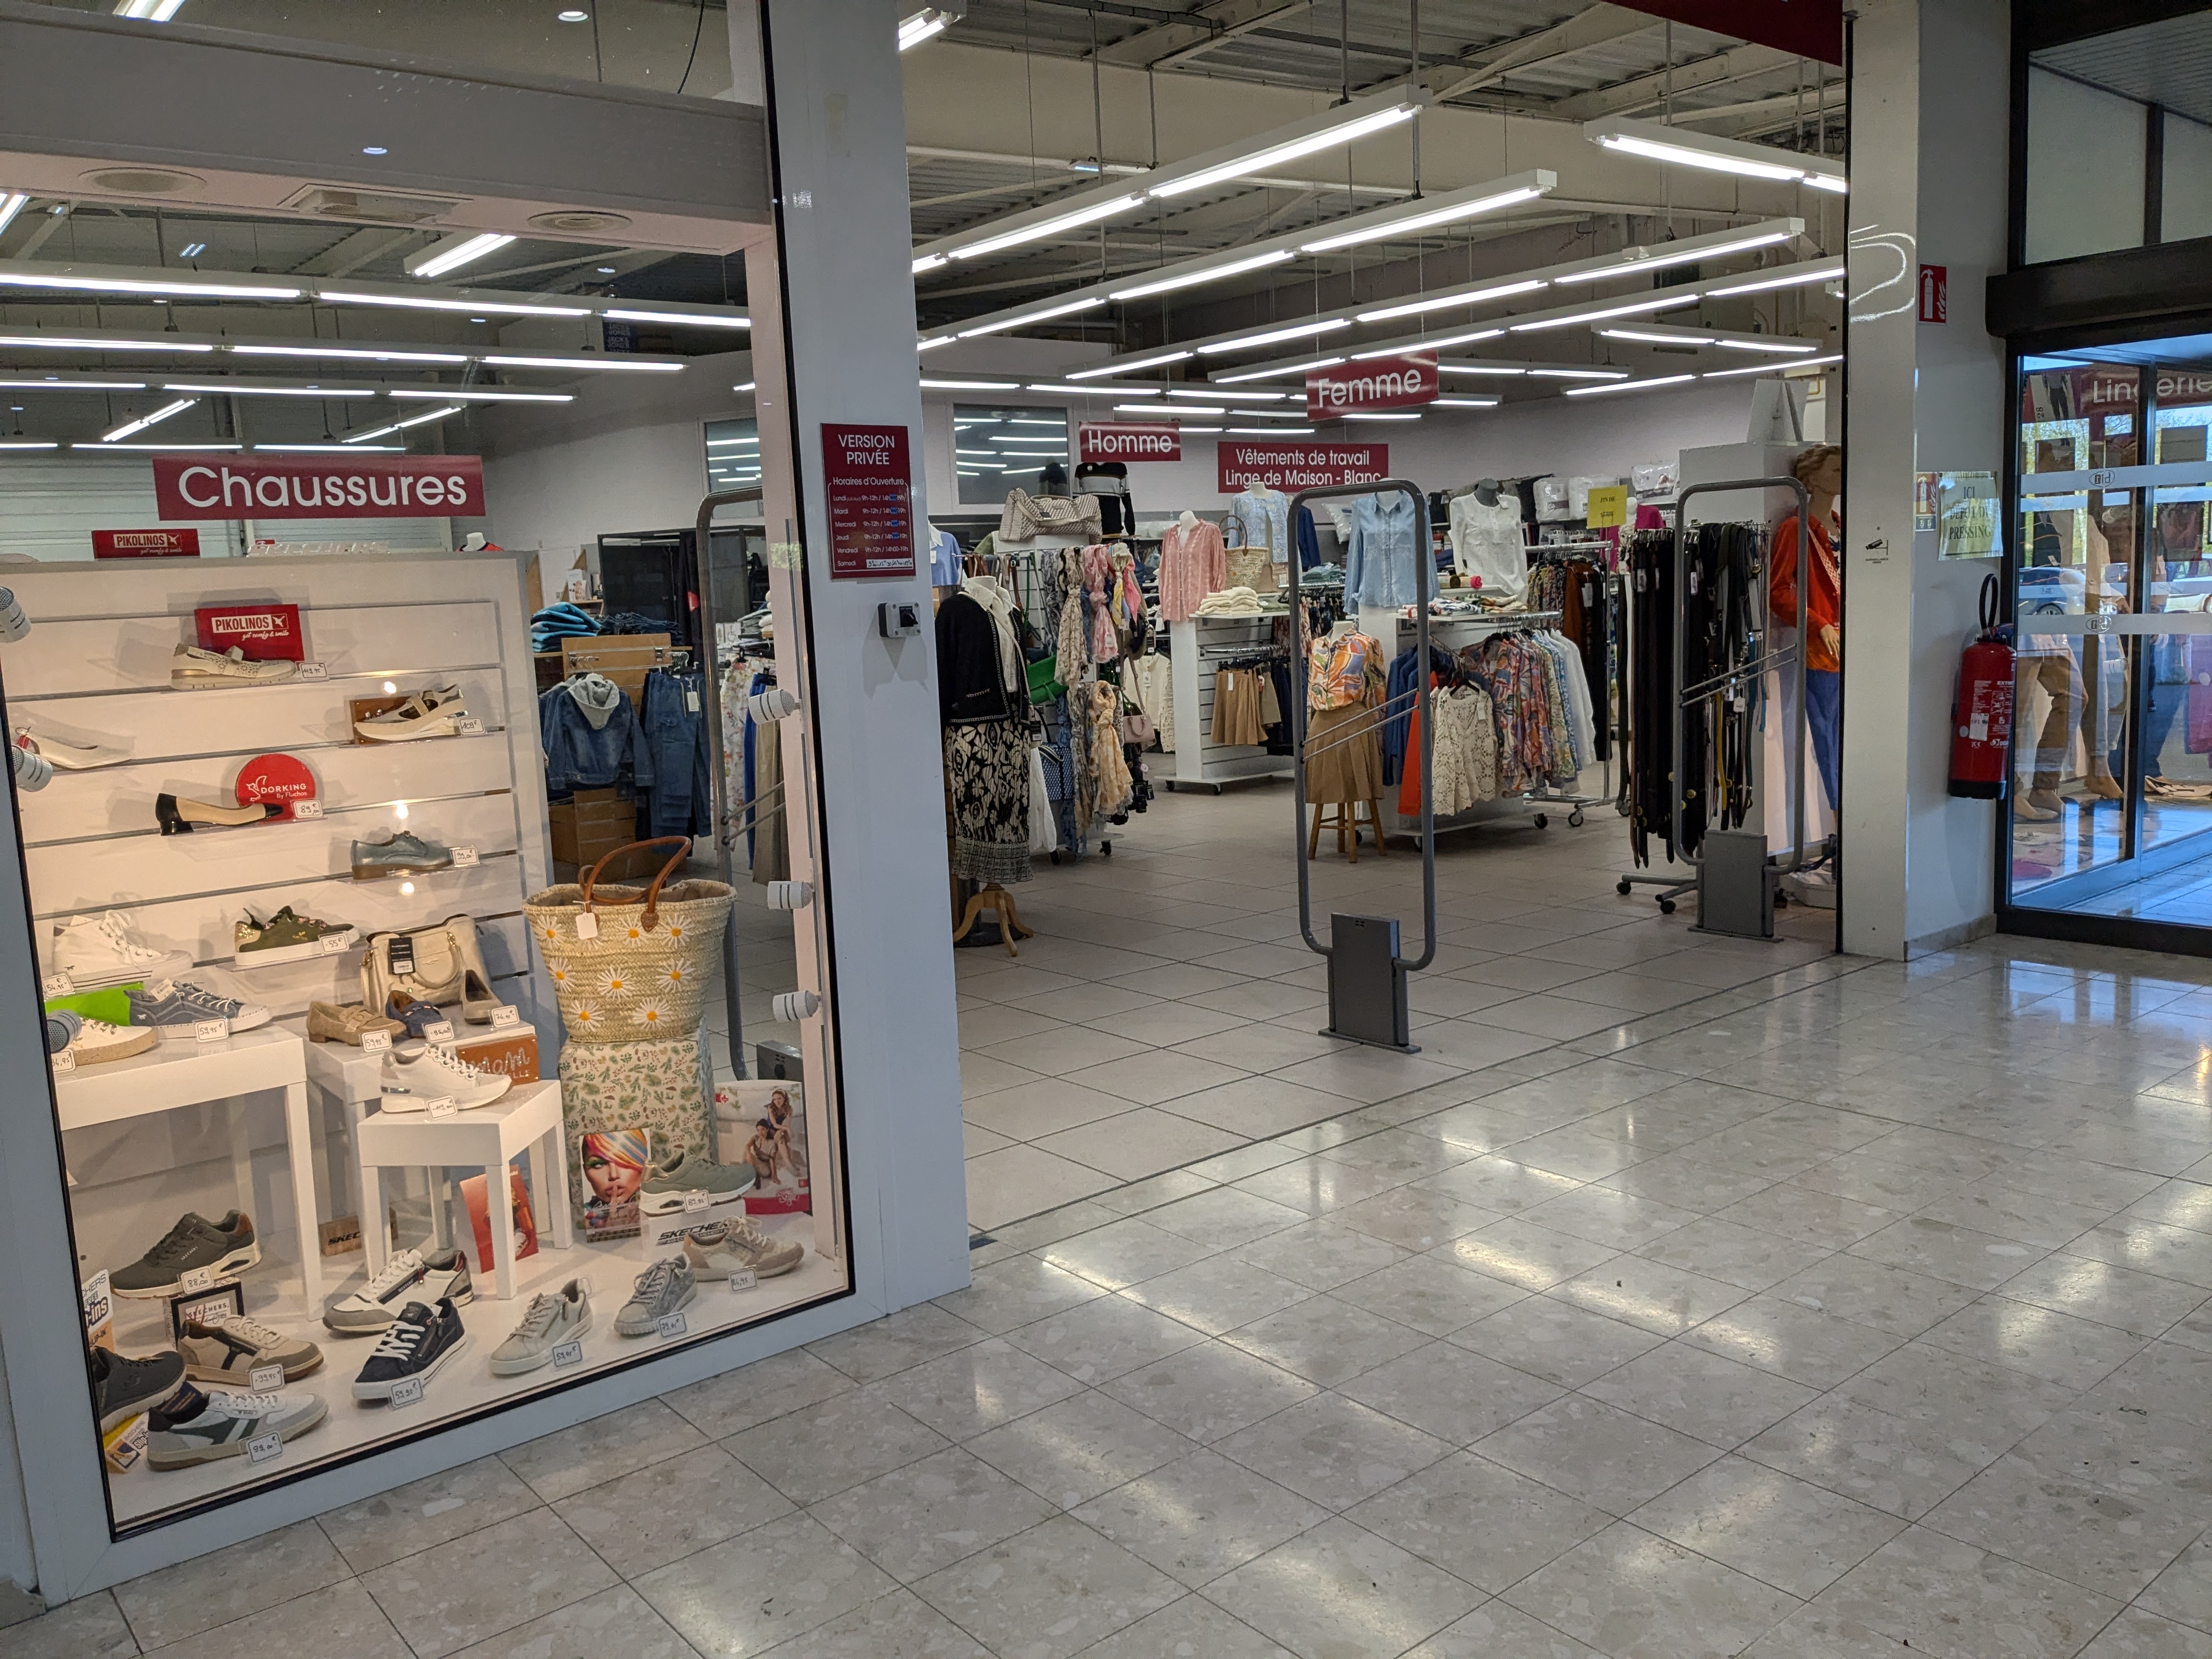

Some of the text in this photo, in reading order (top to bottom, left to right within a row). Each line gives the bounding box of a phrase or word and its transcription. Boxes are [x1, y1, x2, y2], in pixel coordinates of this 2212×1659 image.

[1318, 369, 1421, 408] Femme
[838, 434, 895, 448] VERSION
[1088, 430, 1172, 453] Homme
[847, 449, 889, 465] PRIVÉE
[1236, 449, 1369, 465] Vêtements de travail
[833, 477, 905, 486] Horaires d'Ouverture
[1226, 469, 1260, 488] Linge
[1264, 470, 1282, 485] de
[1285, 469, 1333, 485] Maison
[1345, 469, 1381, 484] Blanc
[179, 466, 467, 508] Chaussures
[1963, 486, 1976, 499] ICI
[1949, 525, 1991, 539] PRESSING
[117, 535, 165, 546] PIKOLINOS
[215, 617, 269, 631] PIKOLINOS
[242, 631, 252, 641] get
[252, 631, 269, 640] comfy
[261, 783, 307, 793] DORKING
